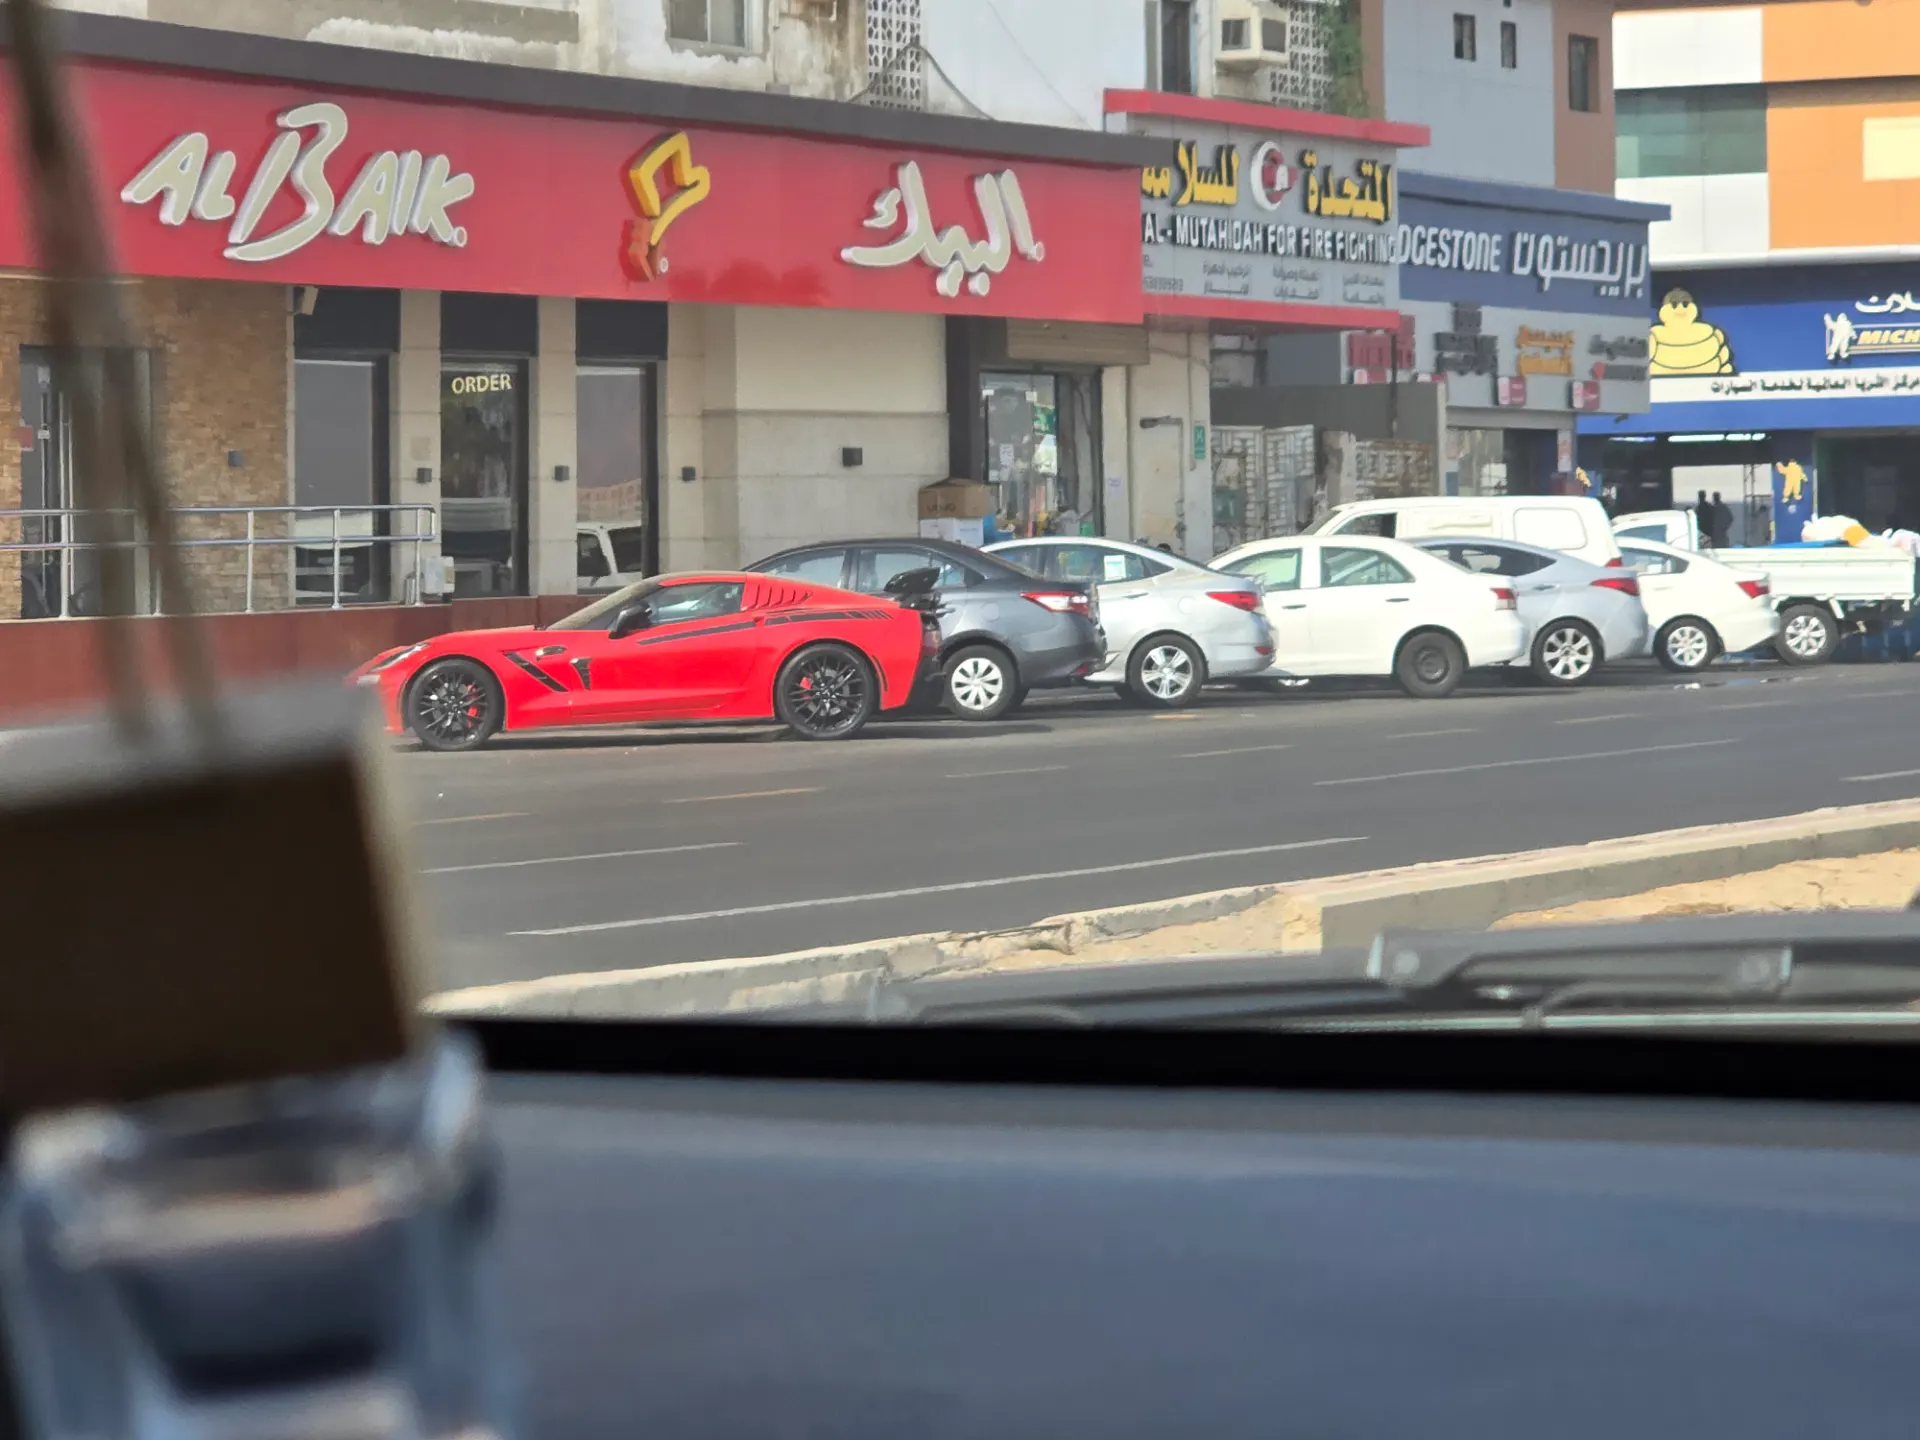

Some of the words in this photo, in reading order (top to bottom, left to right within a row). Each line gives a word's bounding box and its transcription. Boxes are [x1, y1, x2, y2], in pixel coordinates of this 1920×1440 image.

[841, 160, 1036, 297] البيك
[1267, 223, 1297, 255] FOR
[1512, 231, 1647, 298] بريجستون
[451, 373, 513, 394] ORDER
